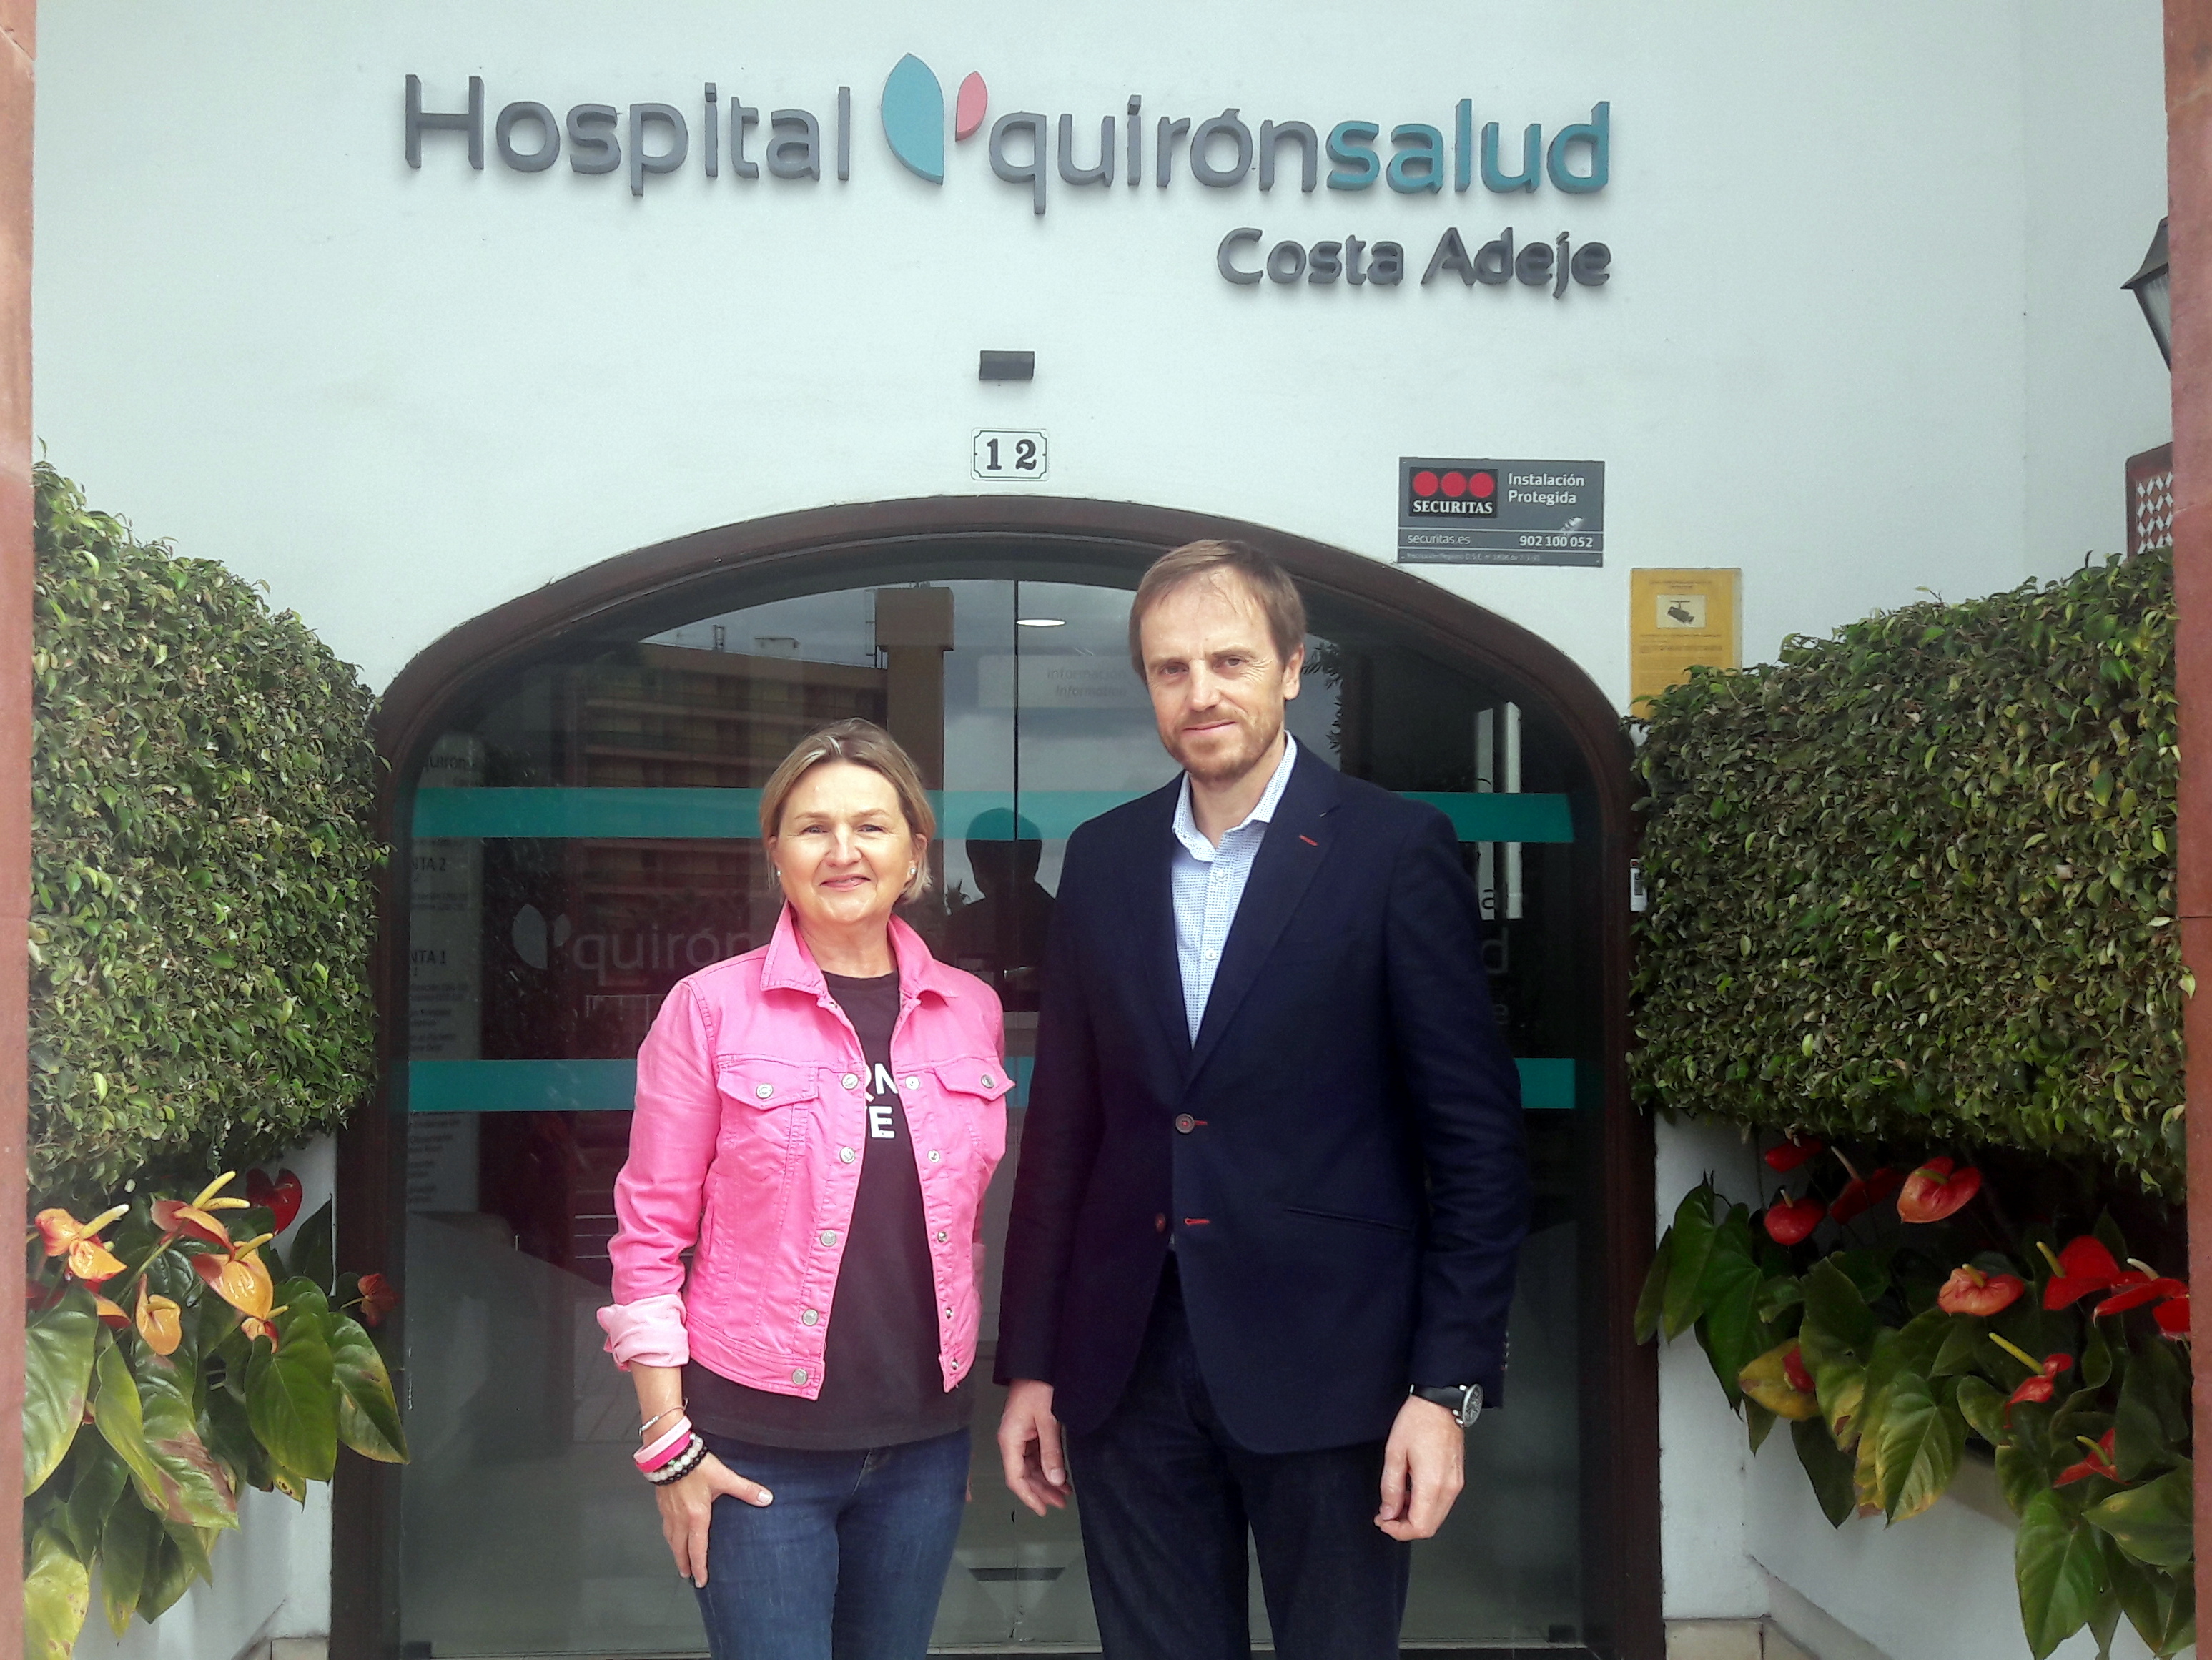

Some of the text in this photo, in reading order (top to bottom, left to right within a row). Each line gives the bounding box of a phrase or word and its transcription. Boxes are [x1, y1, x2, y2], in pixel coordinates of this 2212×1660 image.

[405, 74, 1610, 215] Hospital quirónsalud
[1216, 227, 1611, 297] Costa Adeje
[987, 438, 1037, 470] 12
[1508, 473, 1585, 487] Instalación
[1508, 490, 1577, 506] Protegida
[1412, 500, 1493, 515] SECURITAS
[1407, 533, 1471, 545] securitas.es
[1519, 535, 1594, 548] 902 100 052
